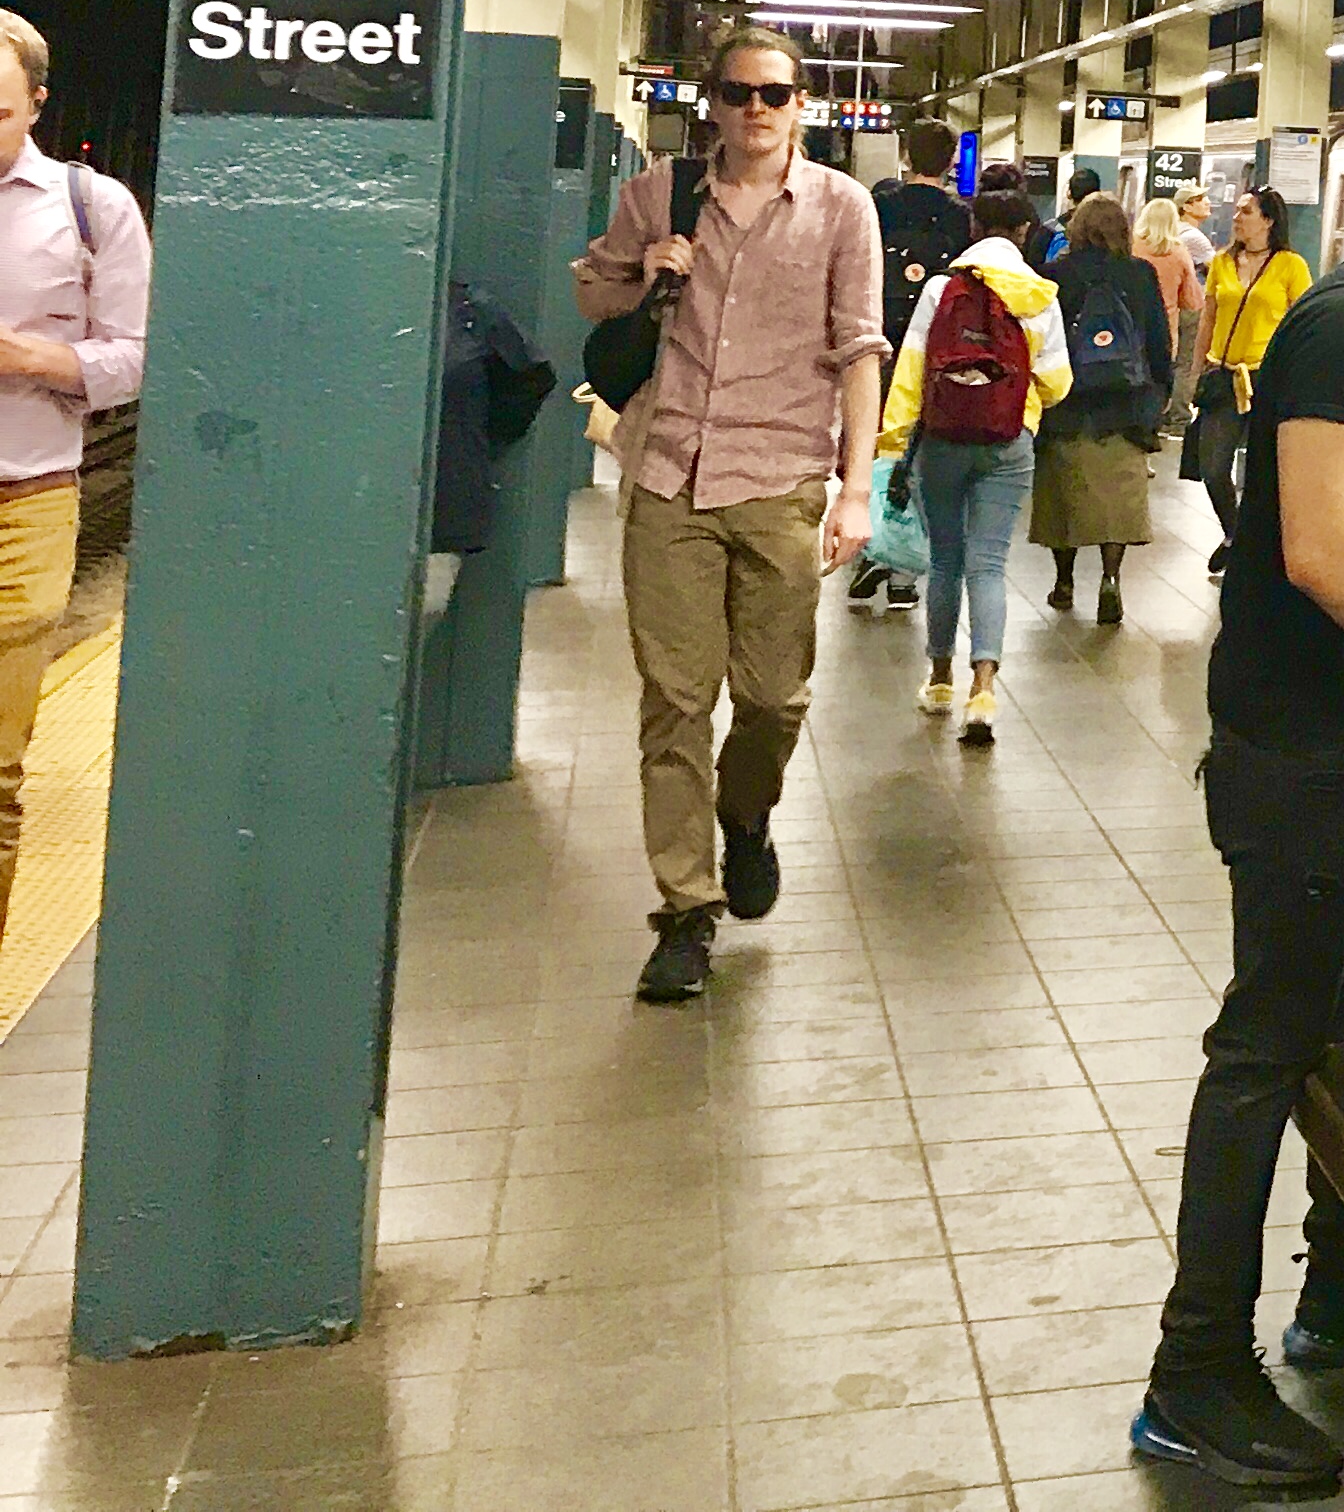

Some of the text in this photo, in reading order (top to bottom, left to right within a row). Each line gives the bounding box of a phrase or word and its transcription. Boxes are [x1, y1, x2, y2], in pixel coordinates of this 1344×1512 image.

[188, 0, 422, 64] Street
[1155, 153, 1183, 172] 42
[1153, 174, 1197, 188] Street
